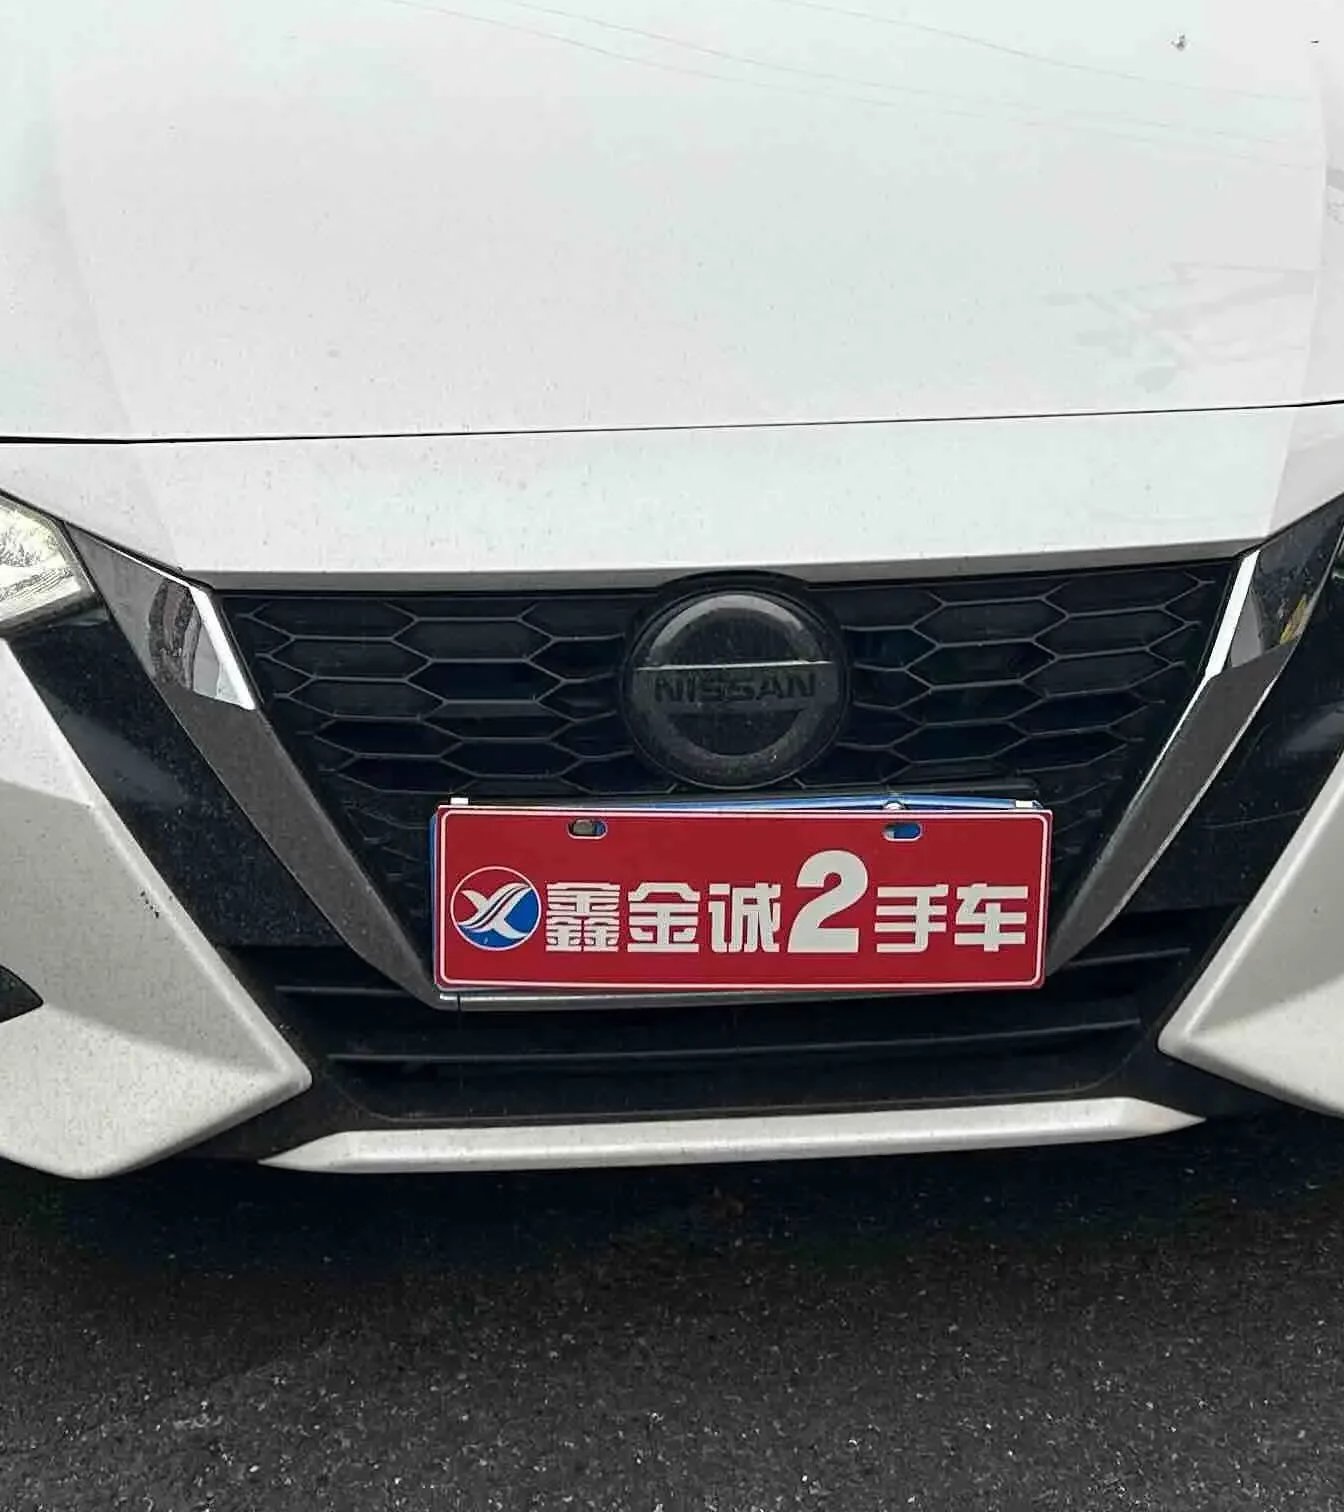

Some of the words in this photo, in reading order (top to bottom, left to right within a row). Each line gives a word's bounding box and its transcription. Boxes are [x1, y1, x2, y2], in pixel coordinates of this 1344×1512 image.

[656, 670, 816, 703] NISSAN
[545, 849, 1029, 953] 鑫金诚2手车
